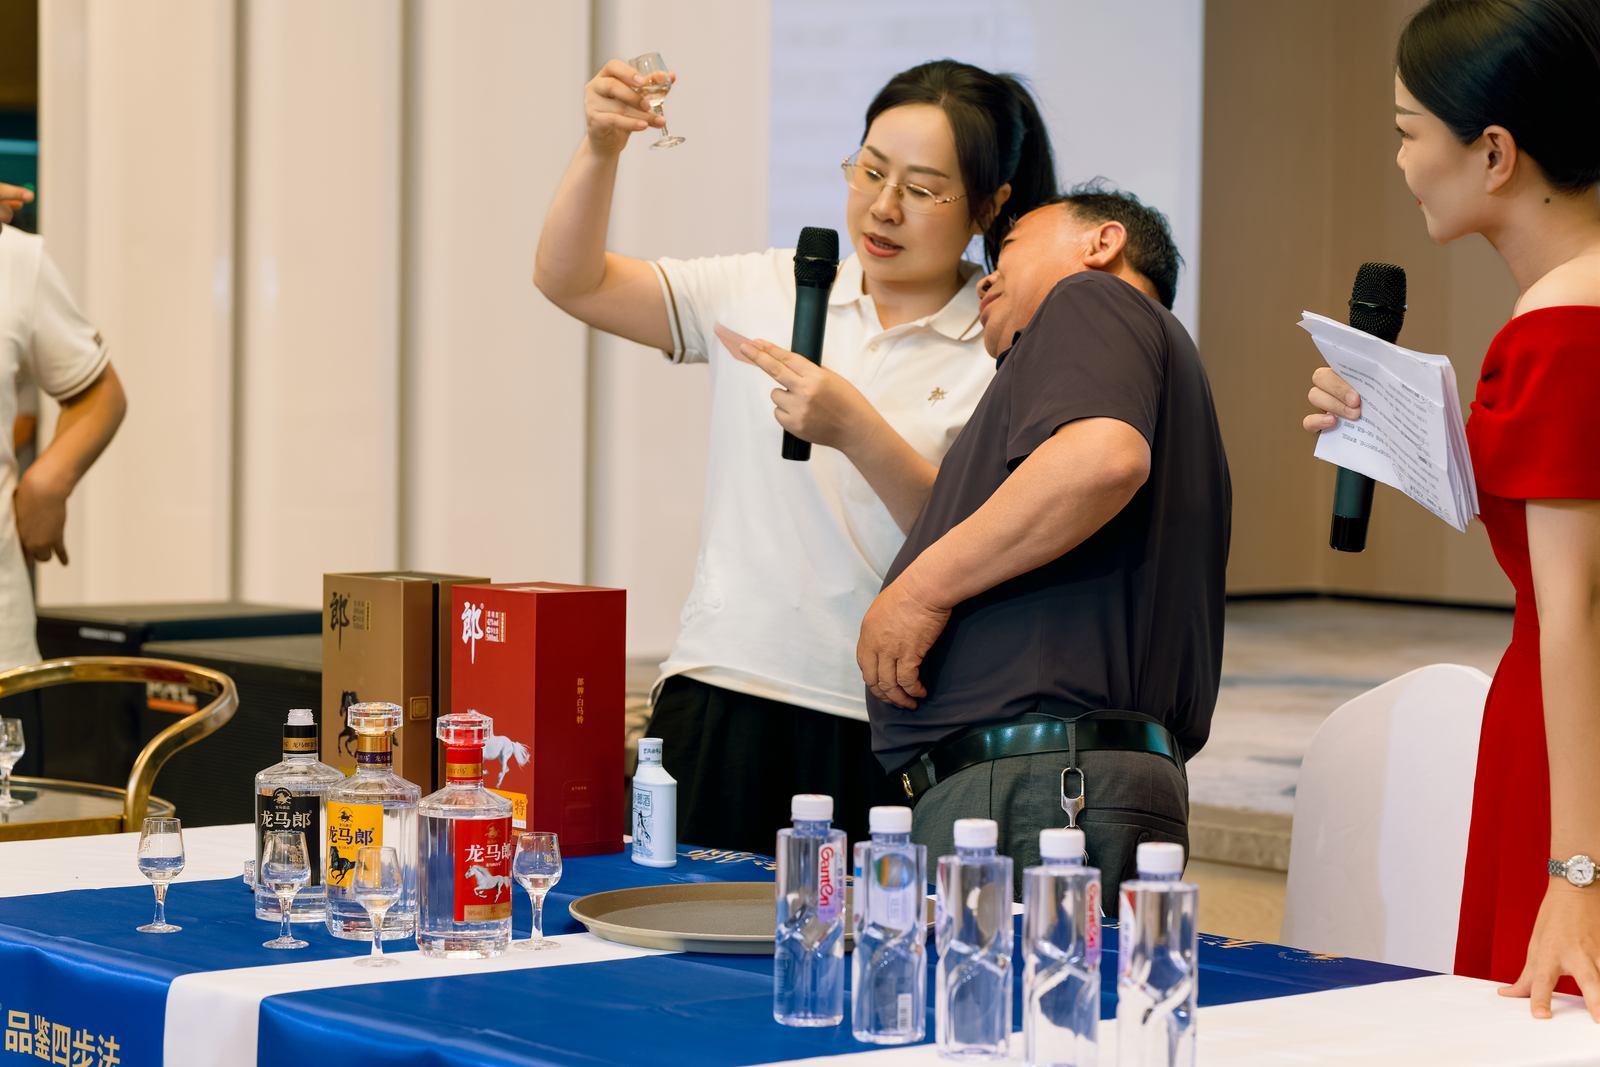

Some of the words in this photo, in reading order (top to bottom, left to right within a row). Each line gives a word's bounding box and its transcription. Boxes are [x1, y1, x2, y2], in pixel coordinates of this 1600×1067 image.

[461, 601, 484, 664] 郎
[260, 809, 312, 829] 龙马郎
[328, 825, 375, 846] 龙马郎
[464, 840, 512, 863] 龙马郎
[5, 1009, 121, 1067] 品鉴四步法
